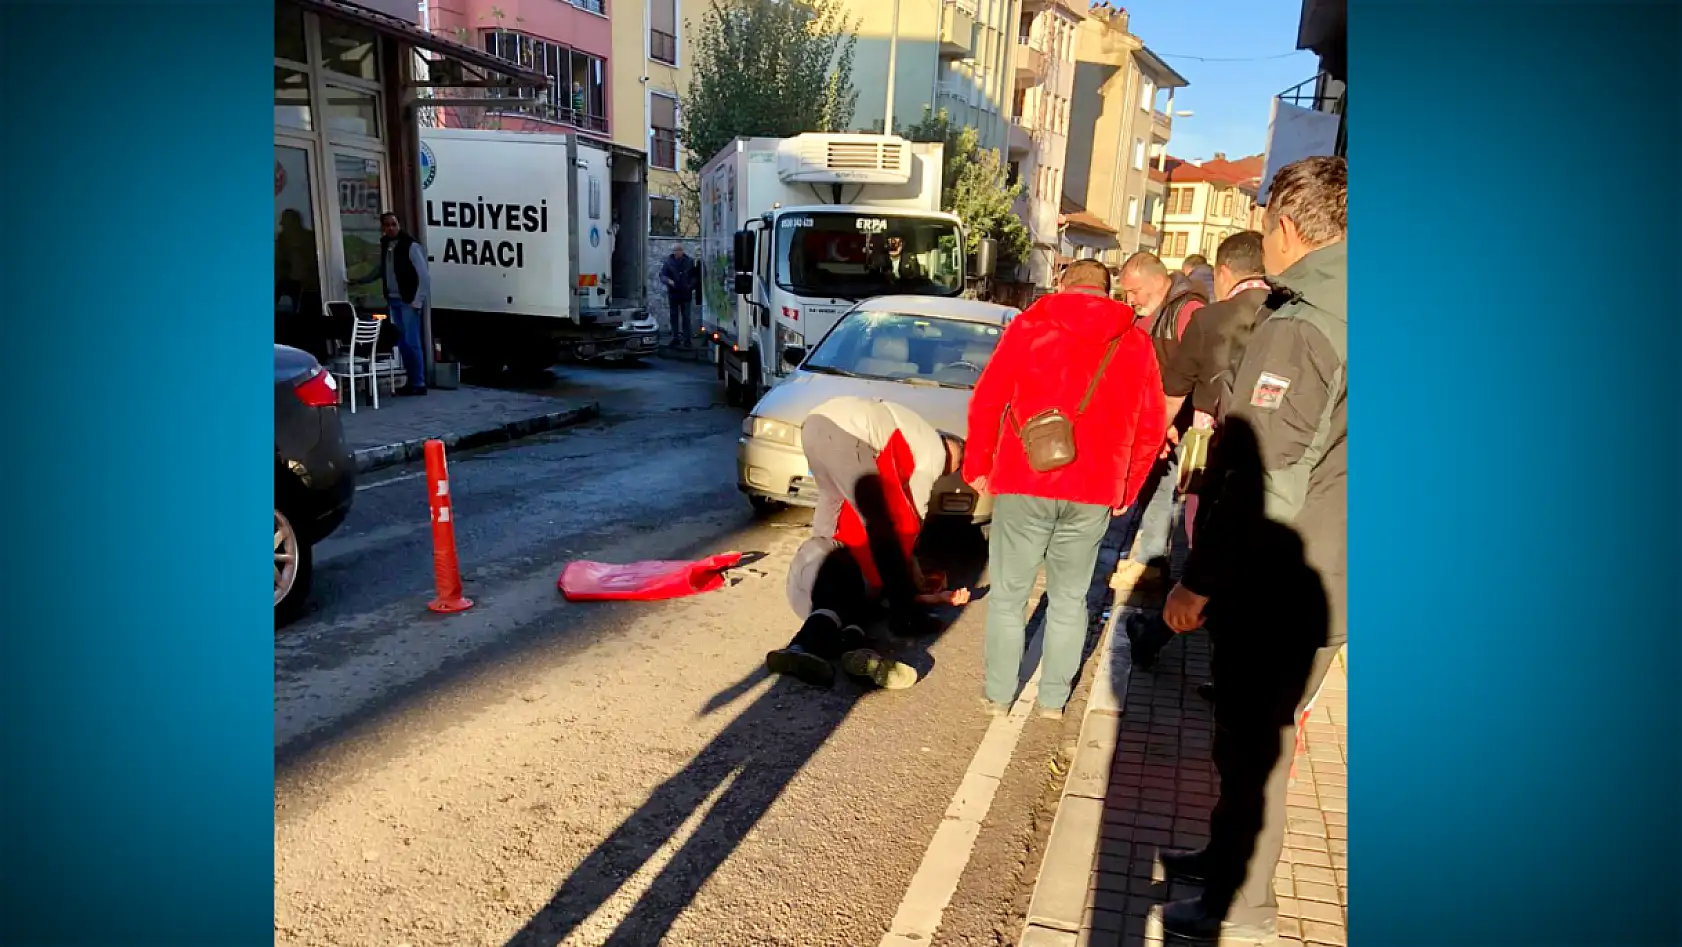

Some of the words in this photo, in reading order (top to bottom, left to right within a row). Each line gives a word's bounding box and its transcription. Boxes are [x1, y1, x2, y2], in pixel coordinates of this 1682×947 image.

[426, 195, 548, 233] LEDİYESİ
[855, 217, 888, 230] ERPA
[442, 238, 523, 268] ARACI
